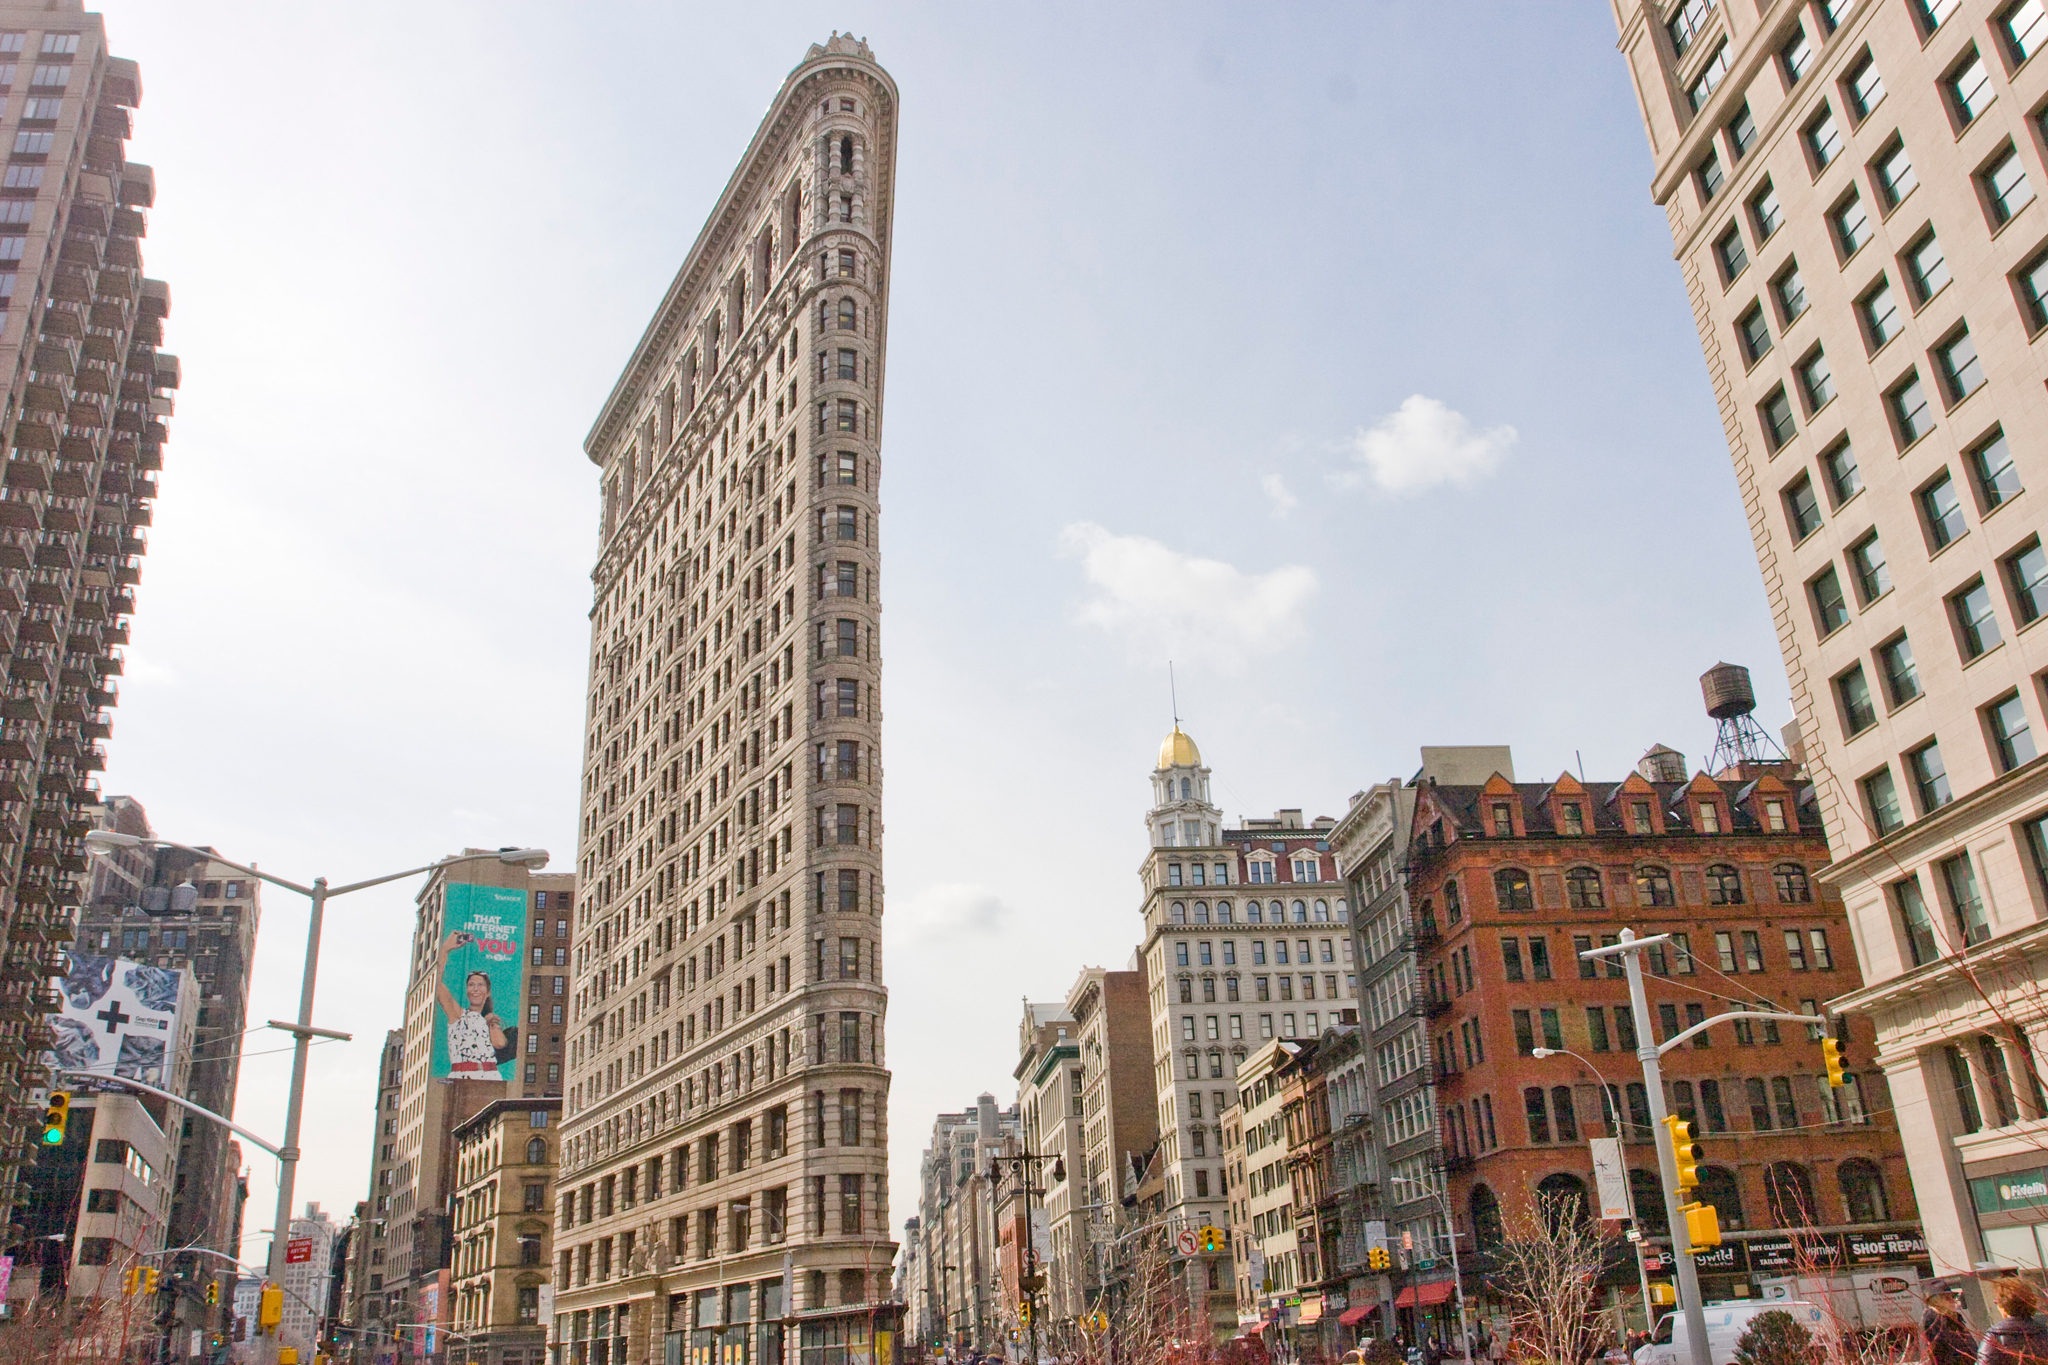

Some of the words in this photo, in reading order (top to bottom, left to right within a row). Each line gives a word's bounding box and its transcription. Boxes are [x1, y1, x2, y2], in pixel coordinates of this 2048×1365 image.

[473, 914, 502, 924] THAT
[463, 921, 517, 934] INTERNET
[485, 932, 493, 940] IS
[495, 933, 509, 941] SO
[476, 938, 516, 955] YOU
[2010, 1182, 2047, 1197] Fidelity
[1605, 1207, 1625, 1216] GREY
[1749, 1244, 1762, 1252] DRY
[1852, 1242, 1887, 1255] SHOE
